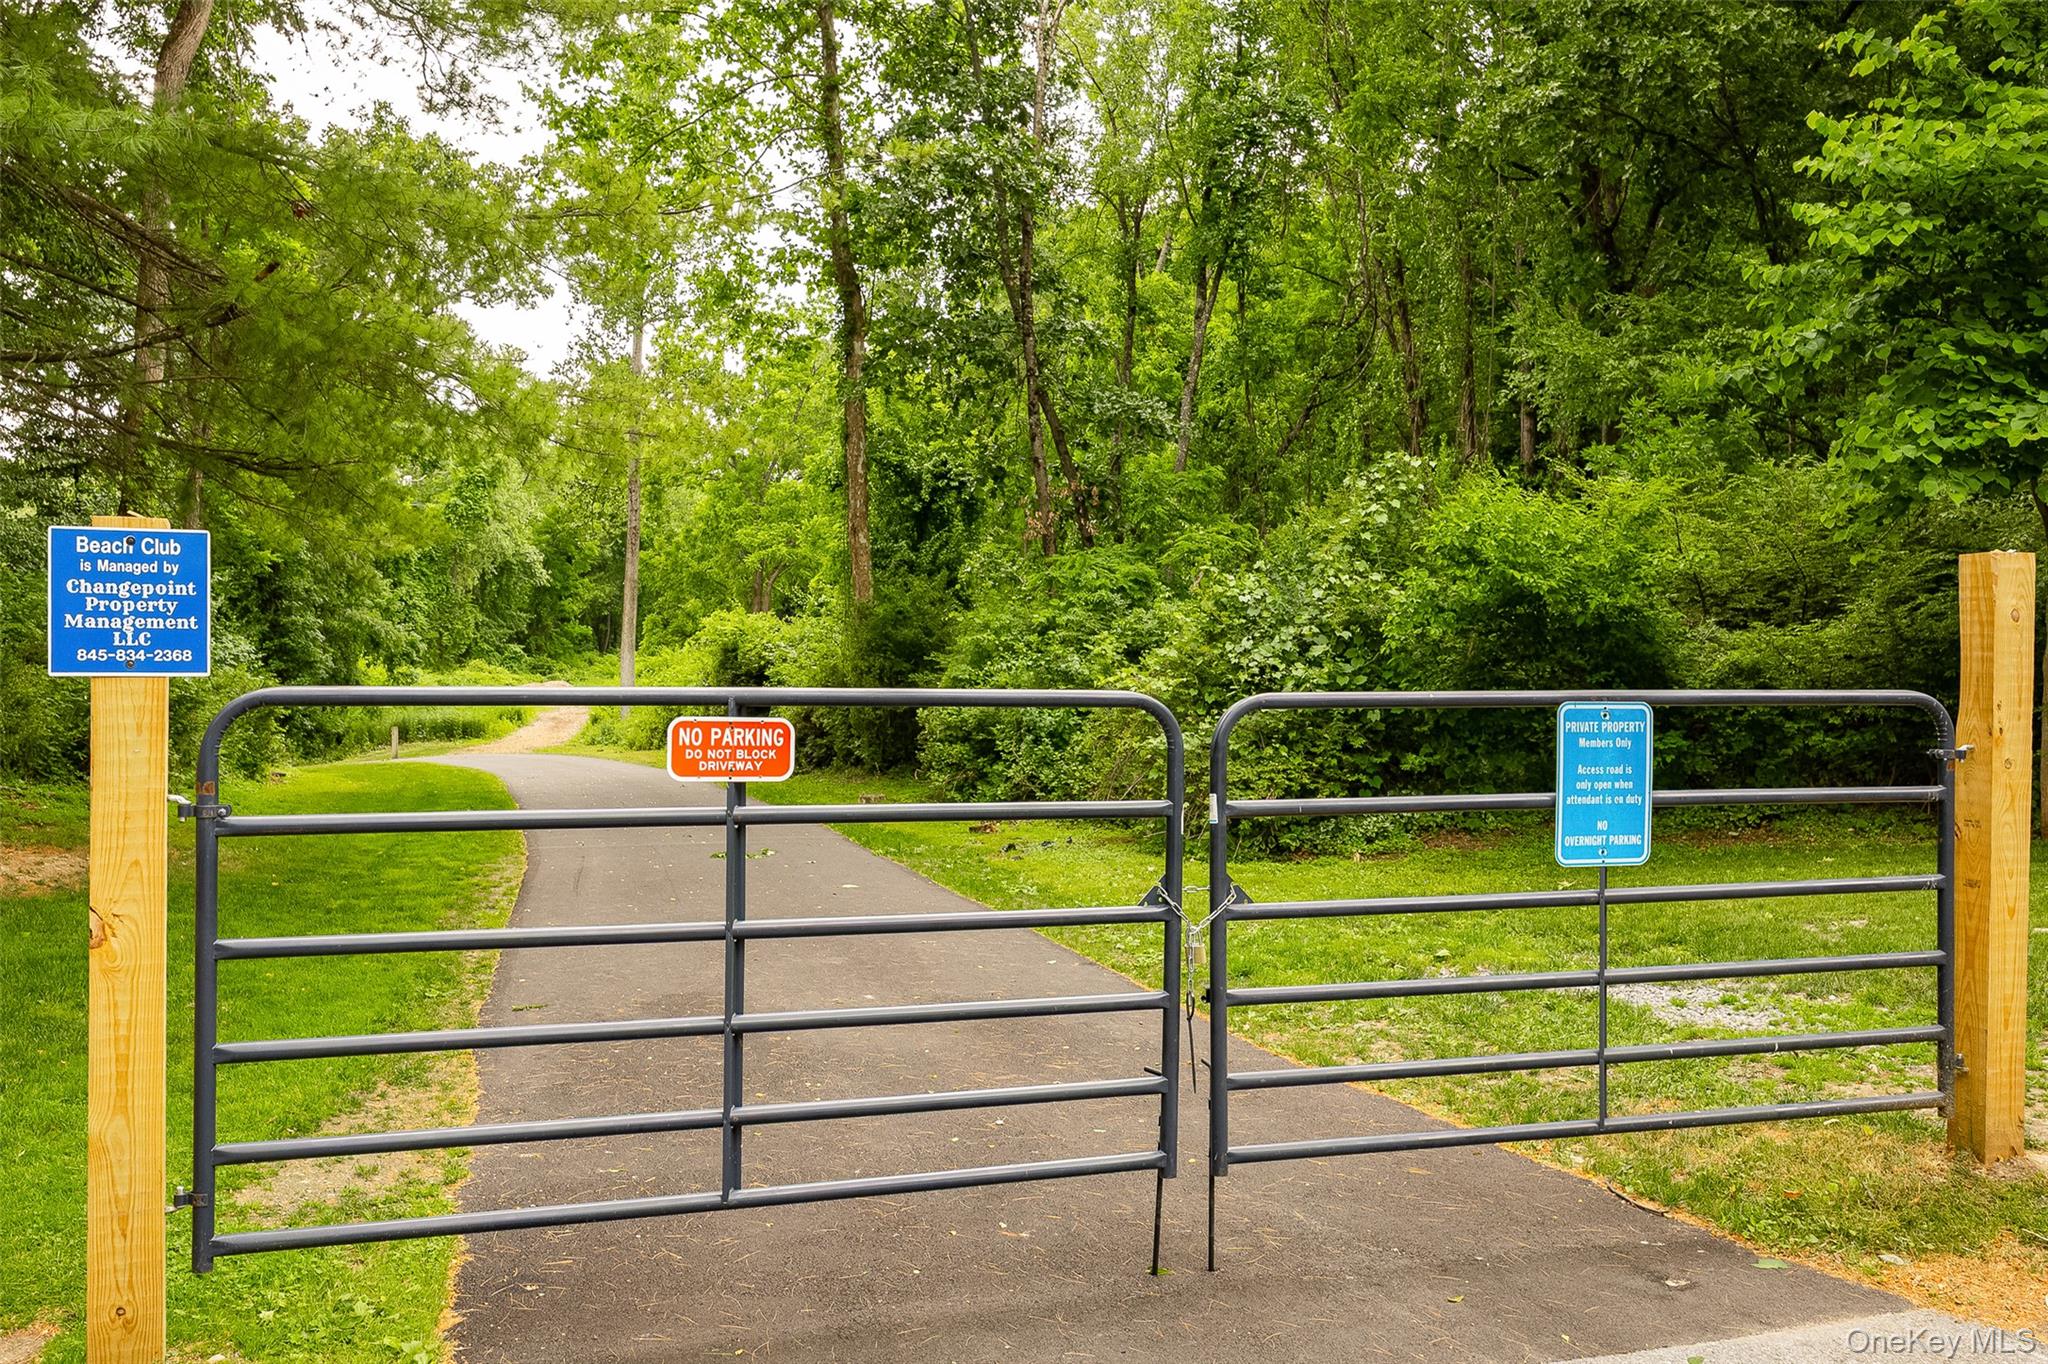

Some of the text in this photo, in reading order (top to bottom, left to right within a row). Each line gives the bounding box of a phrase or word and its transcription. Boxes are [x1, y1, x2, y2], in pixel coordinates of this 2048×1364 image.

[76, 536, 181, 555] Beach Club
[80, 559, 179, 575] is Managed by
[66, 579, 197, 598] Changepoint
[85, 597, 178, 615] Property
[64, 614, 198, 632] Management
[113, 632, 151, 646] LLC
[76, 649, 192, 662] 845-834-2368
[1565, 721, 1645, 733] PRIVATE PROPERTY
[678, 728, 784, 747] NO PARKING
[1578, 737, 1632, 750] Members Only
[685, 749, 776, 759] DO NOT BLOCK
[699, 761, 763, 771] DRIVEWAY
[1577, 763, 1633, 775] Access road is
[1576, 779, 1633, 791] only open when
[1566, 794, 1603, 805] attendant
[1605, 794, 1612, 804] is
[1625, 794, 1642, 806] duty
[1597, 820, 1608, 831] NO
[1564, 834, 1642, 847] OVERNIGHT PARKING
